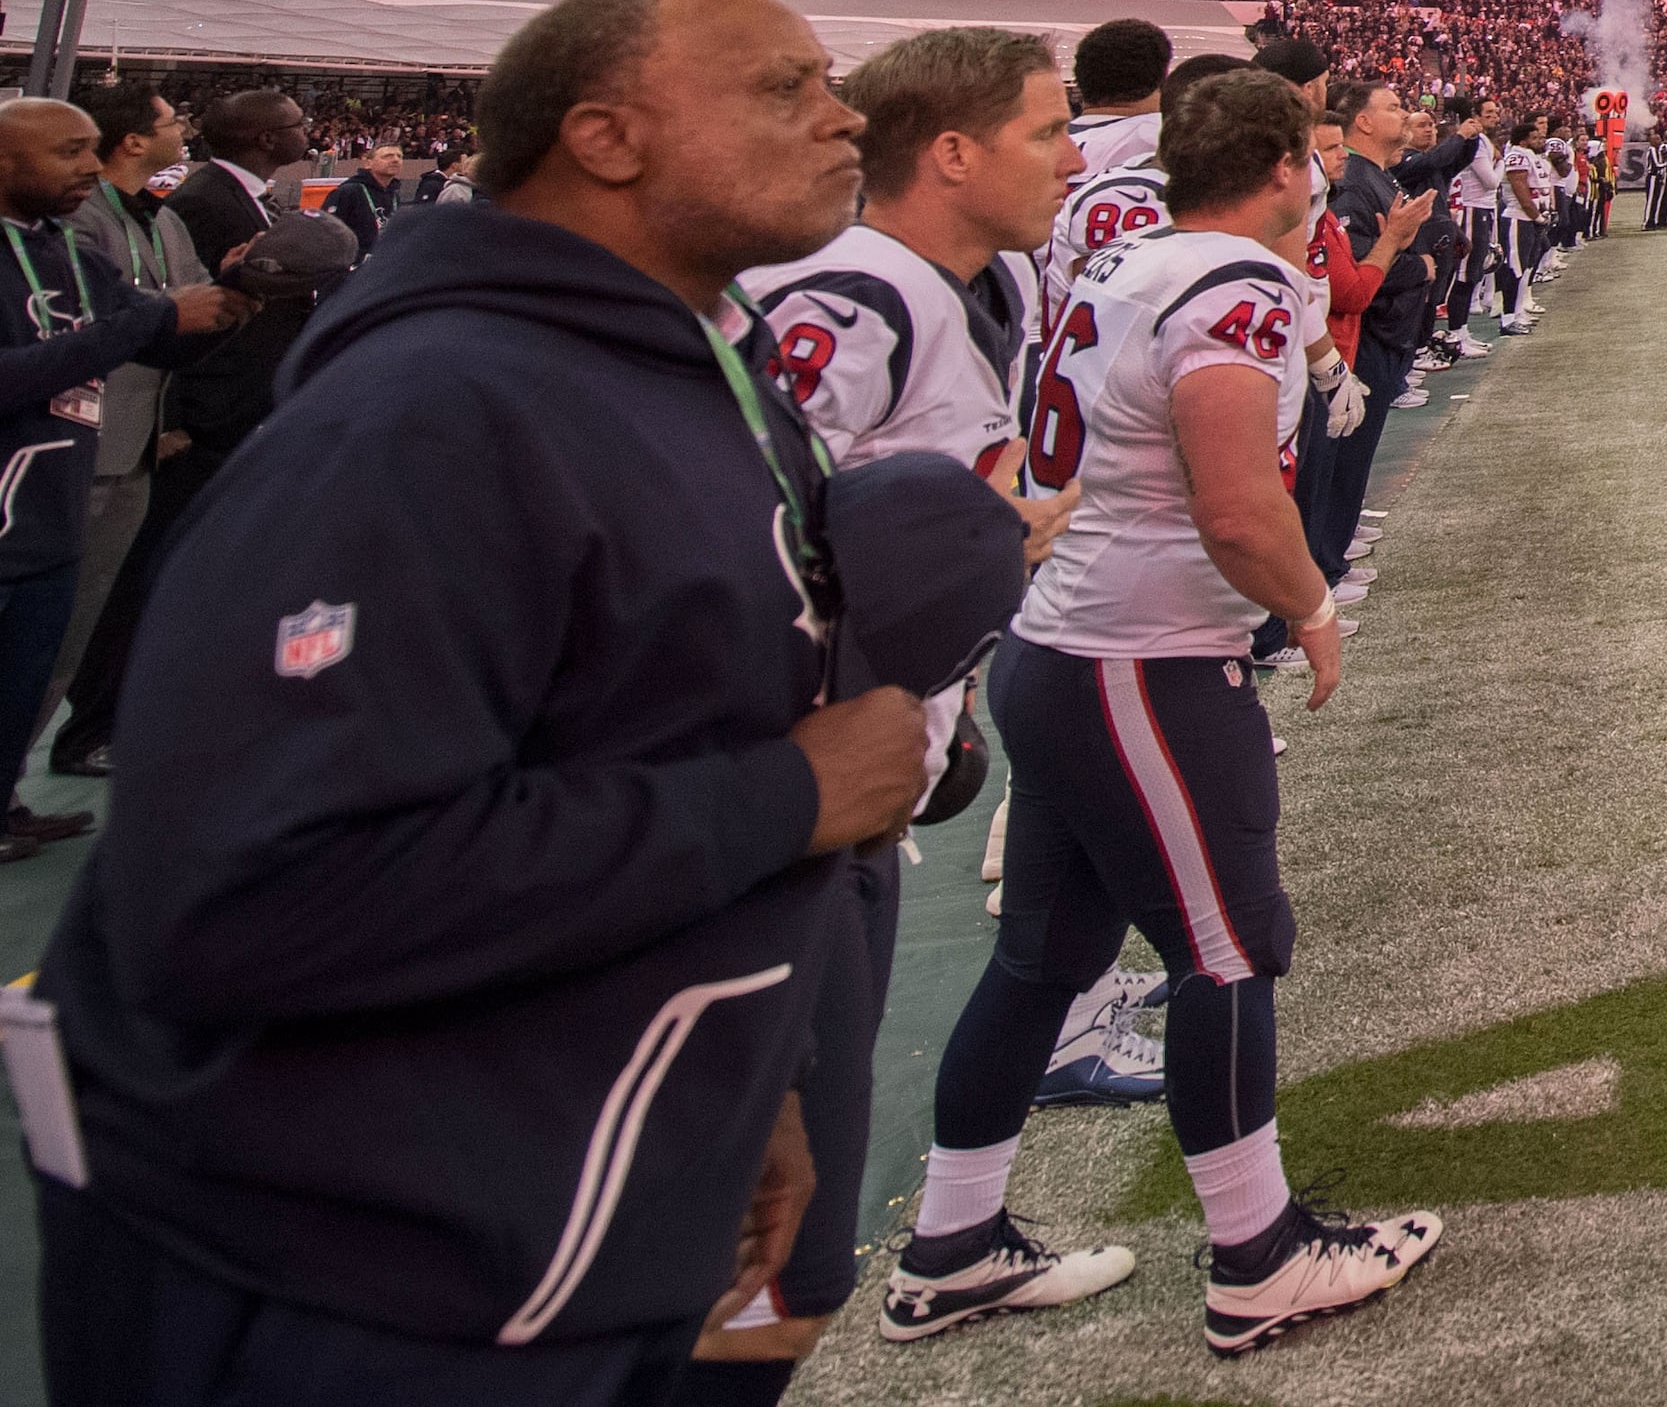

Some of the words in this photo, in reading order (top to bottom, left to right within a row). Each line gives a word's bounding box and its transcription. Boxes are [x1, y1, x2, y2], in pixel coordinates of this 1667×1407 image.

[1509, 155, 1525, 167] 27
[1208, 300, 1292, 360] 46
[1028, 292, 1099, 491] 6
